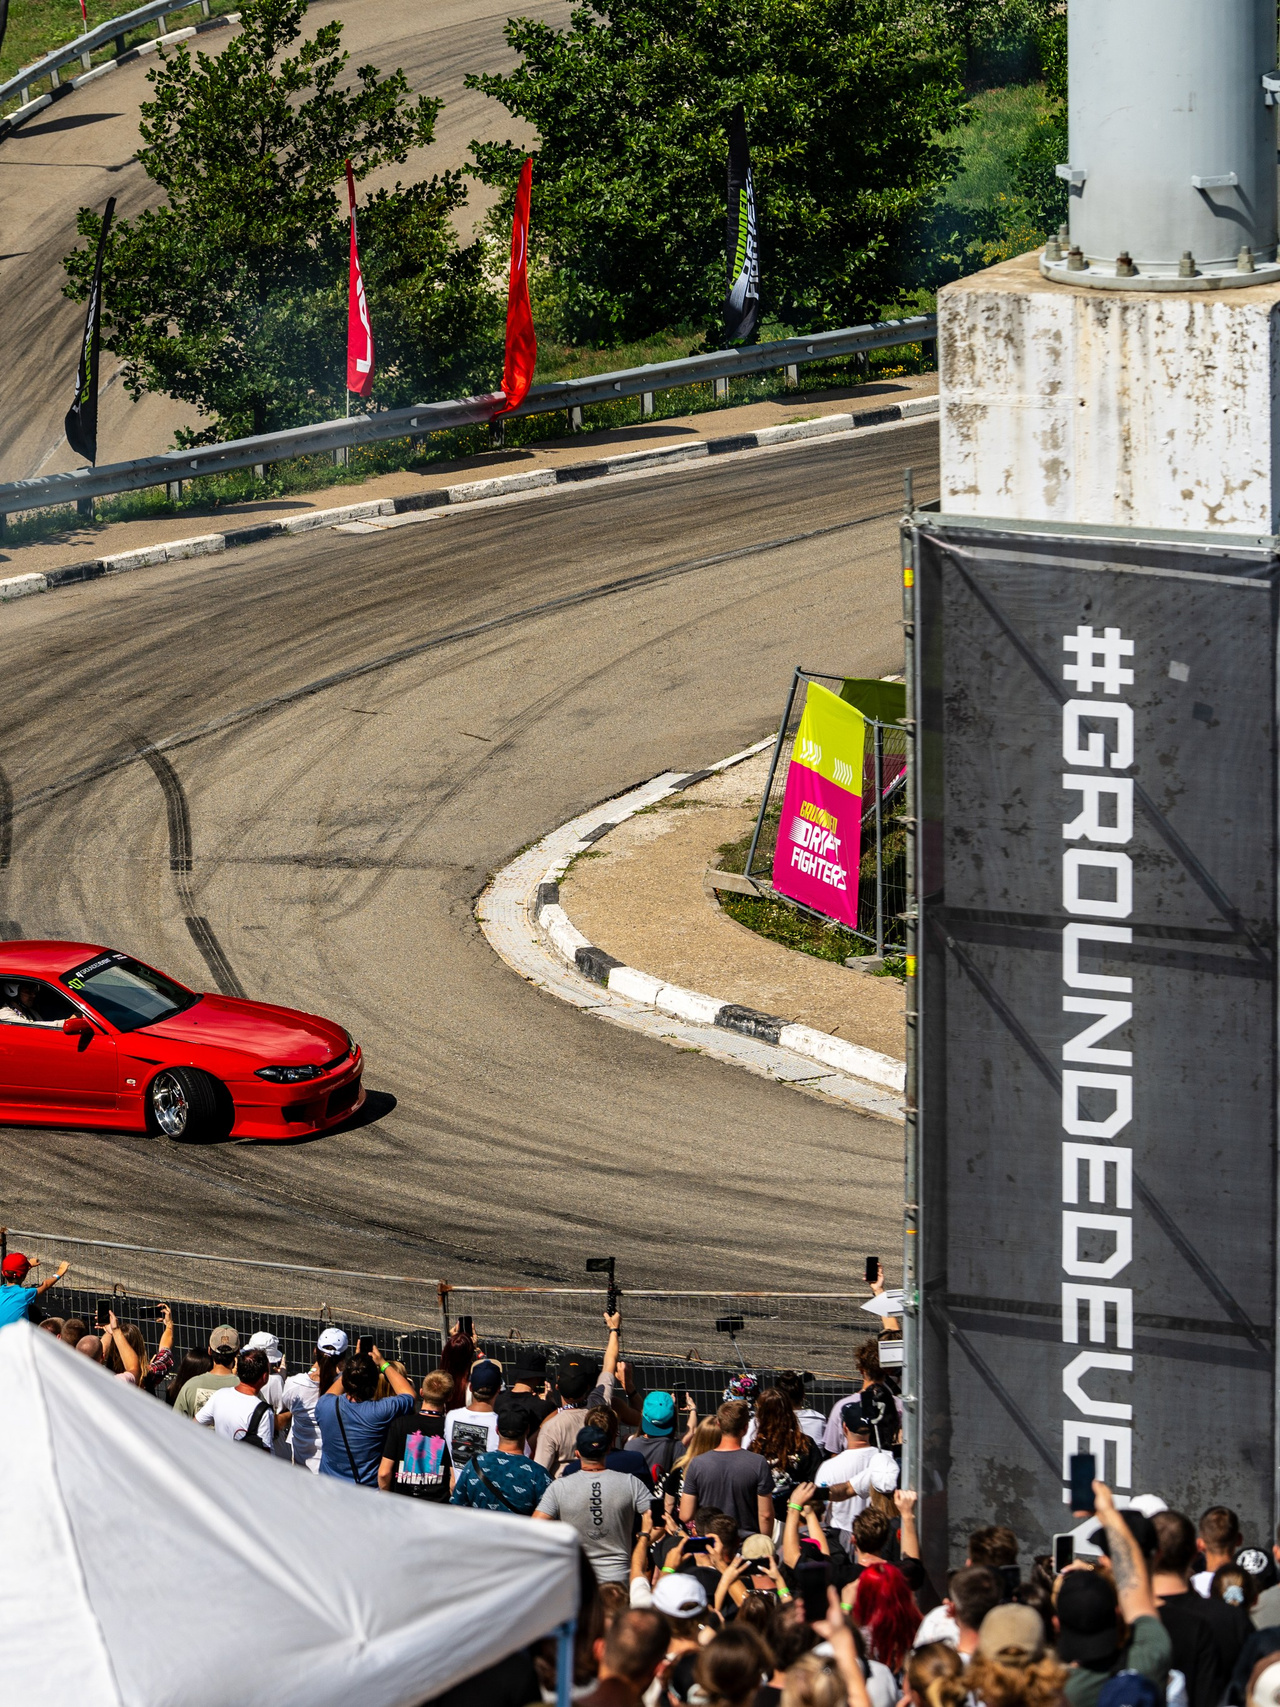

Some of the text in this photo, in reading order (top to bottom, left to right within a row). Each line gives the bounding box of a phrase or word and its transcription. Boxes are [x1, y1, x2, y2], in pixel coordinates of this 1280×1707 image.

[791, 846, 847, 890] FIGHTERS
[68, 978, 85, 990] 07
[589, 1481, 604, 1526] adidas
